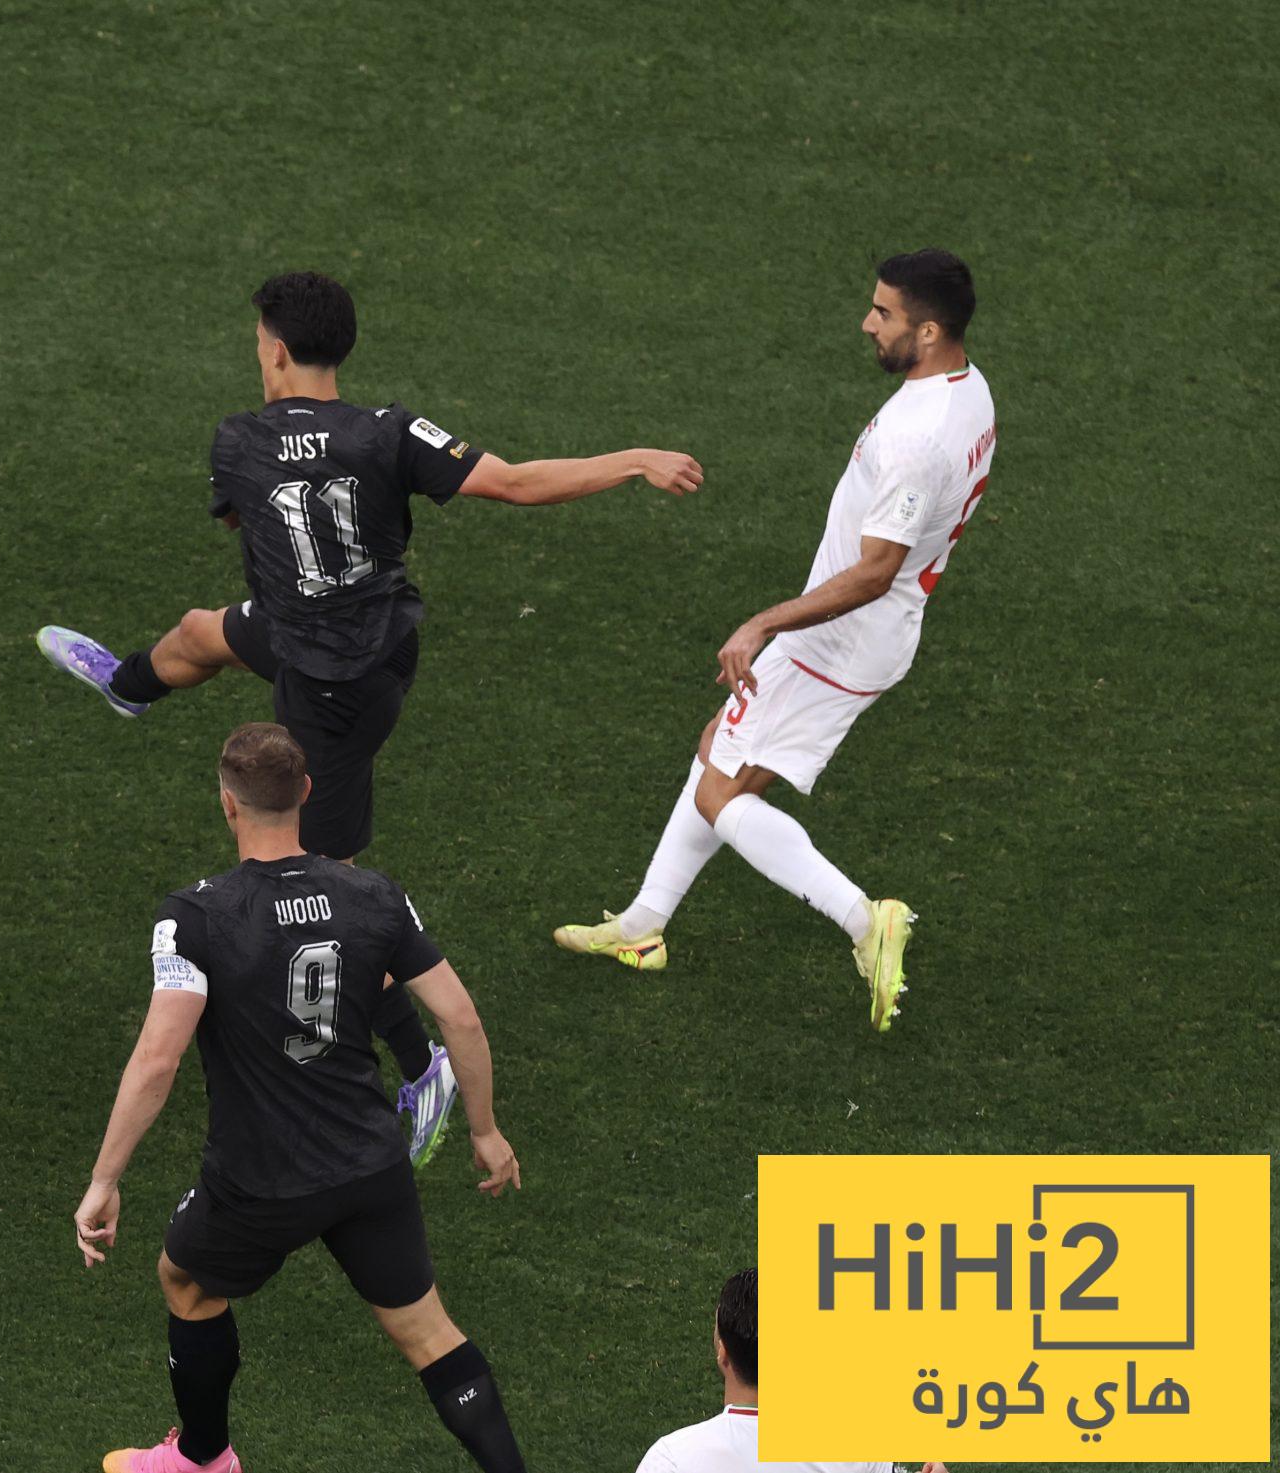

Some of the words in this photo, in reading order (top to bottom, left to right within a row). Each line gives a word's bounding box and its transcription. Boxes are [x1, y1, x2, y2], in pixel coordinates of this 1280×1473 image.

[277, 432, 329, 462] JUST
[267, 475, 378, 598] 11
[274, 894, 332, 926] WOOD
[157, 964, 191, 974] UNITES
[283, 940, 342, 1065] 9
[458, 1387, 477, 1405] NZ
